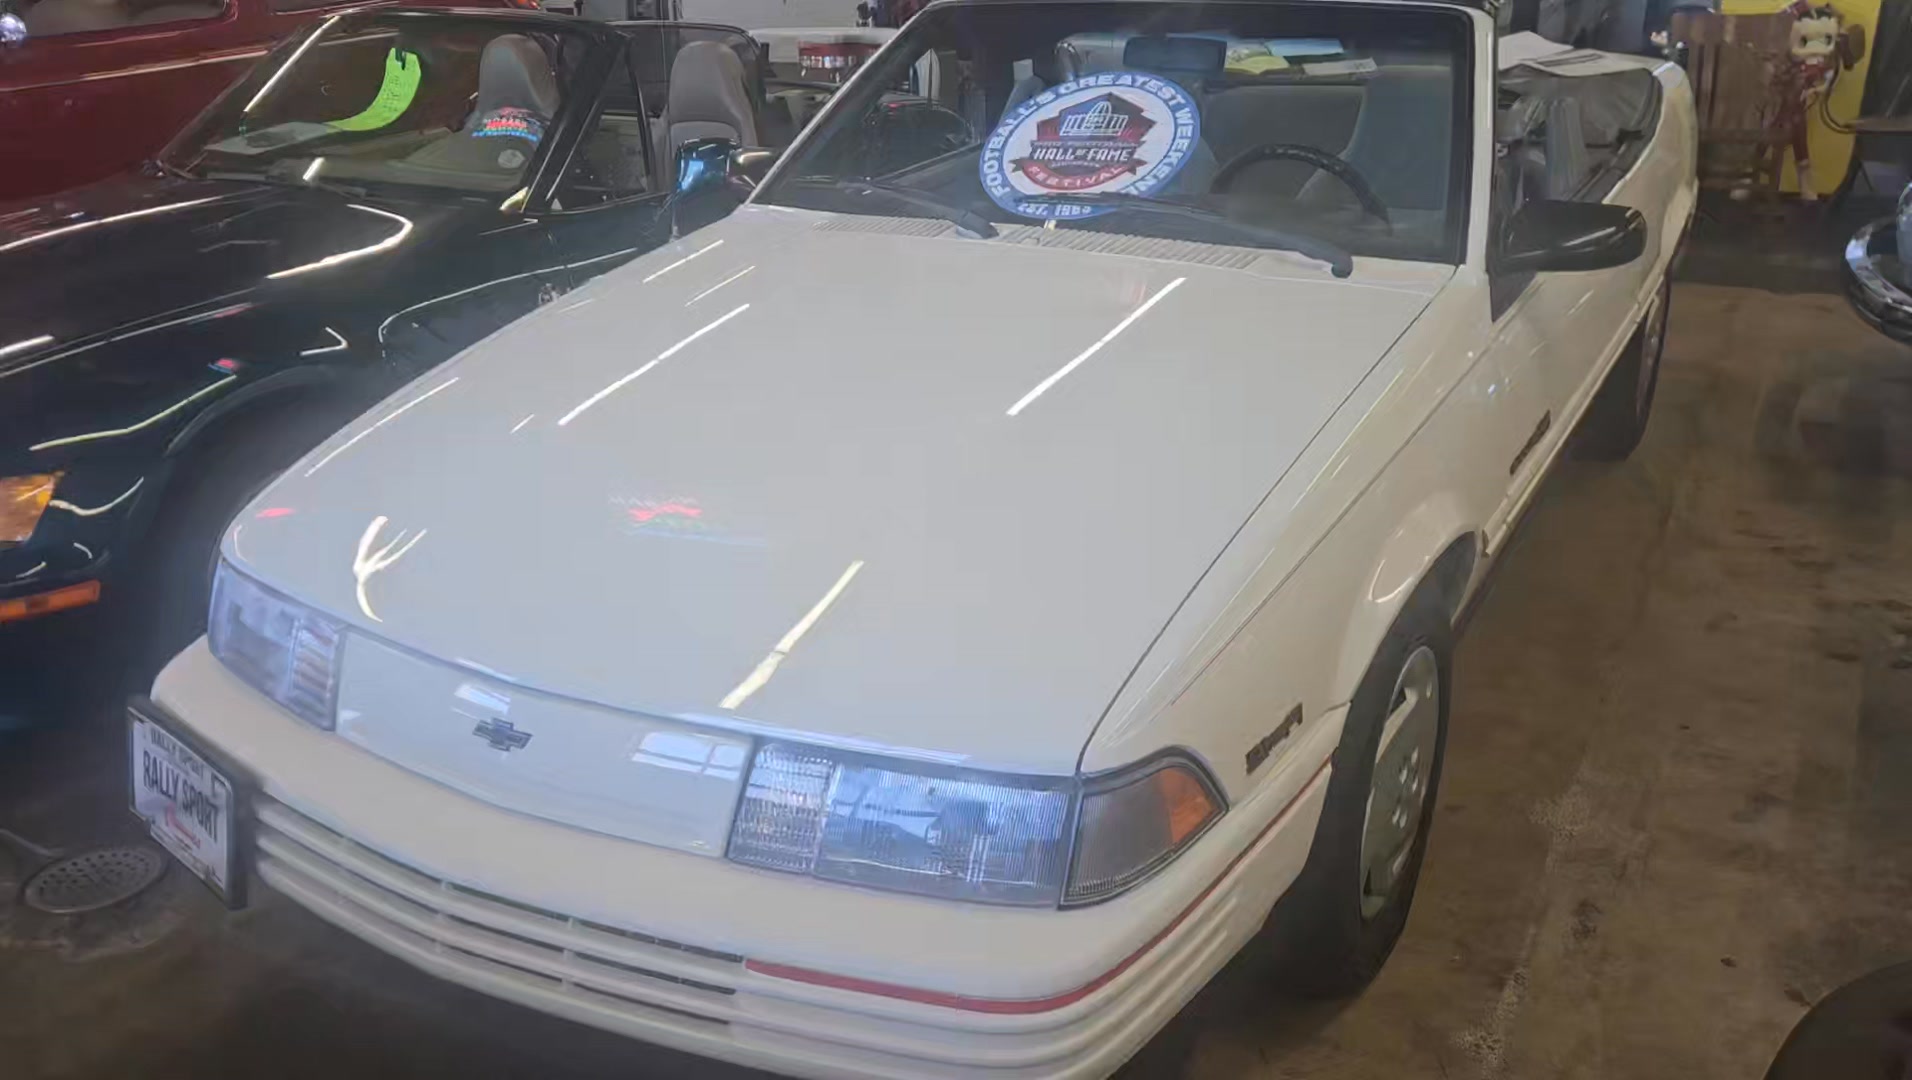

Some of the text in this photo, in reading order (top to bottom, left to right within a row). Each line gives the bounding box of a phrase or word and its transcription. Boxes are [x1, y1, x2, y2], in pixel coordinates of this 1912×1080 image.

[983, 91, 1056, 198] FOOTBALL'S
[1058, 74, 1185, 106] GREATEST
[1033, 148, 1075, 160] HALL
[1087, 148, 1132, 161] FAME
[1028, 166, 1123, 187] FESTIVAL
[143, 750, 219, 843] RALLY SPORT
